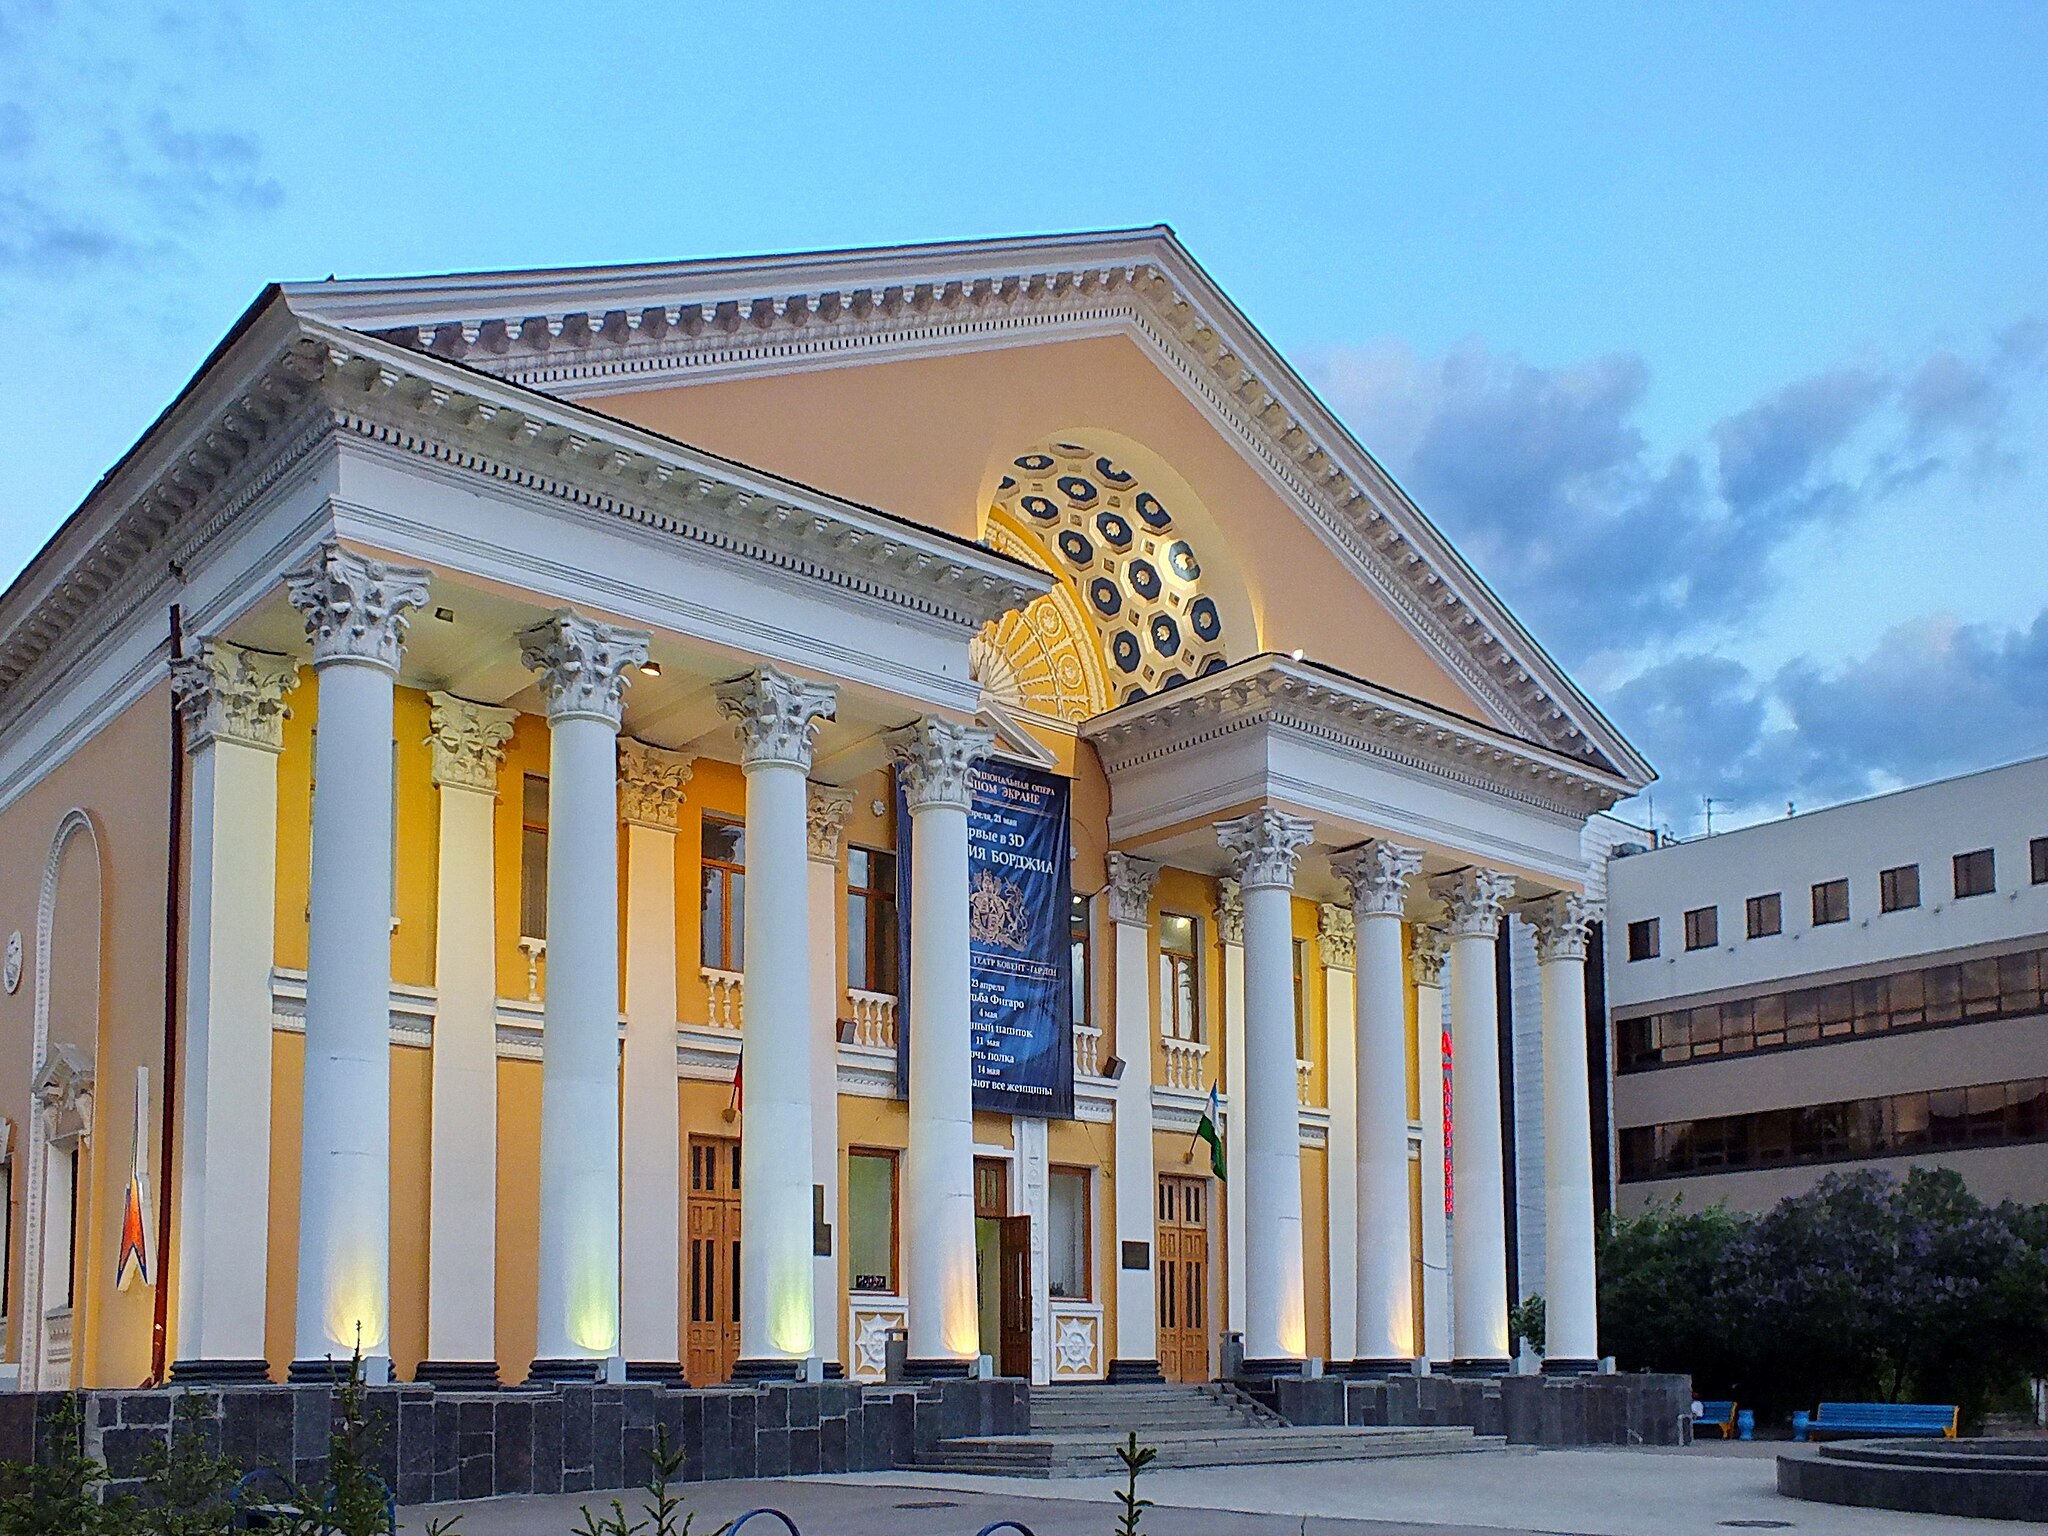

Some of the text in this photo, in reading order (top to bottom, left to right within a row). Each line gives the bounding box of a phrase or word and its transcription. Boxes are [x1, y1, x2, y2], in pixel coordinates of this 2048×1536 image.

[977, 770, 1055, 796] ЦИОНАЛЬНАЯ ОПЕРА
[971, 776, 1041, 805] НОМ ЭКРАНЕ
[994, 813, 1002, 823] 21
[1003, 817, 1018, 827] мая
[1000, 834, 1006, 844] в
[1008, 833, 1025, 848] 3D
[991, 850, 1054, 875] БОРДЖИА
[973, 955, 996, 966] ТЕАТР
[971, 978, 1005, 992] 23 апреля
[990, 994, 1025, 1011] Фигаро
[979, 1008, 983, 1017] 4
[995, 1025, 1033, 1038] напиток
[976, 1036, 984, 1045] 11
[987, 1052, 1015, 1063] полка
[977, 1065, 1001, 1075] 14 мая
[972, 1079, 1053, 1095] ают все женщины
